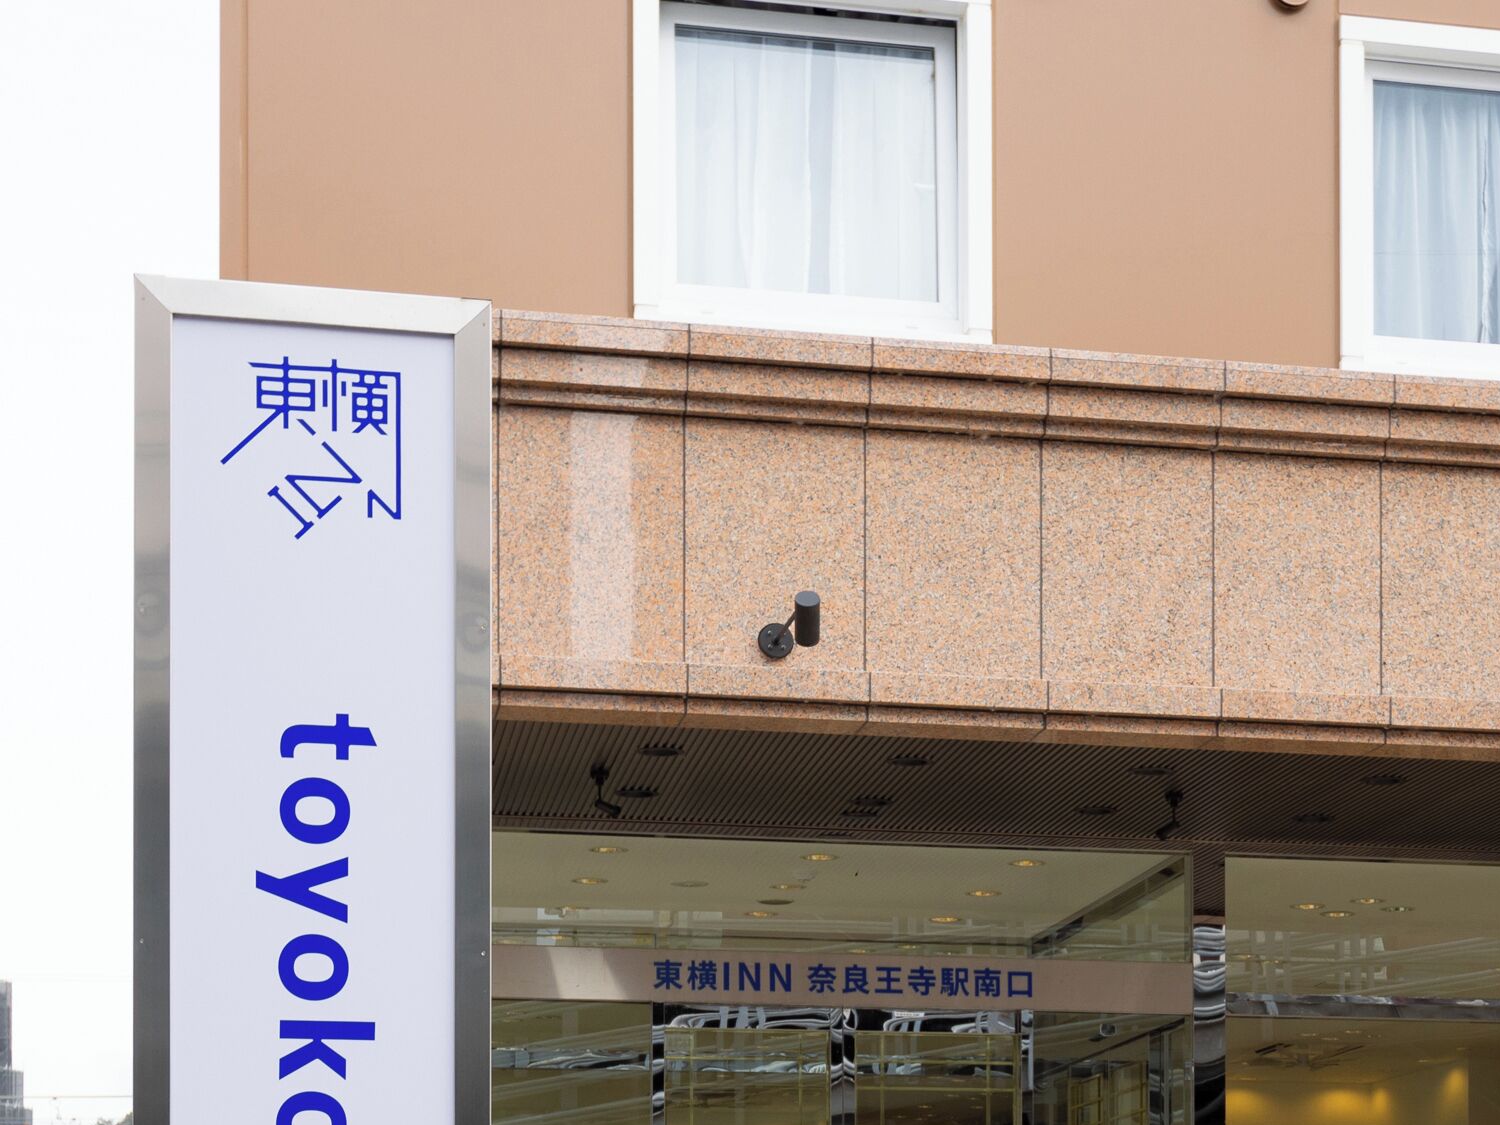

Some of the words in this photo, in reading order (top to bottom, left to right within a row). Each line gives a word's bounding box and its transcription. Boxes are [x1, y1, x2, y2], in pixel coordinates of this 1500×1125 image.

[653, 959, 793, 993] 東横INN
[807, 965, 1034, 999] 奈良王寺駅南口
